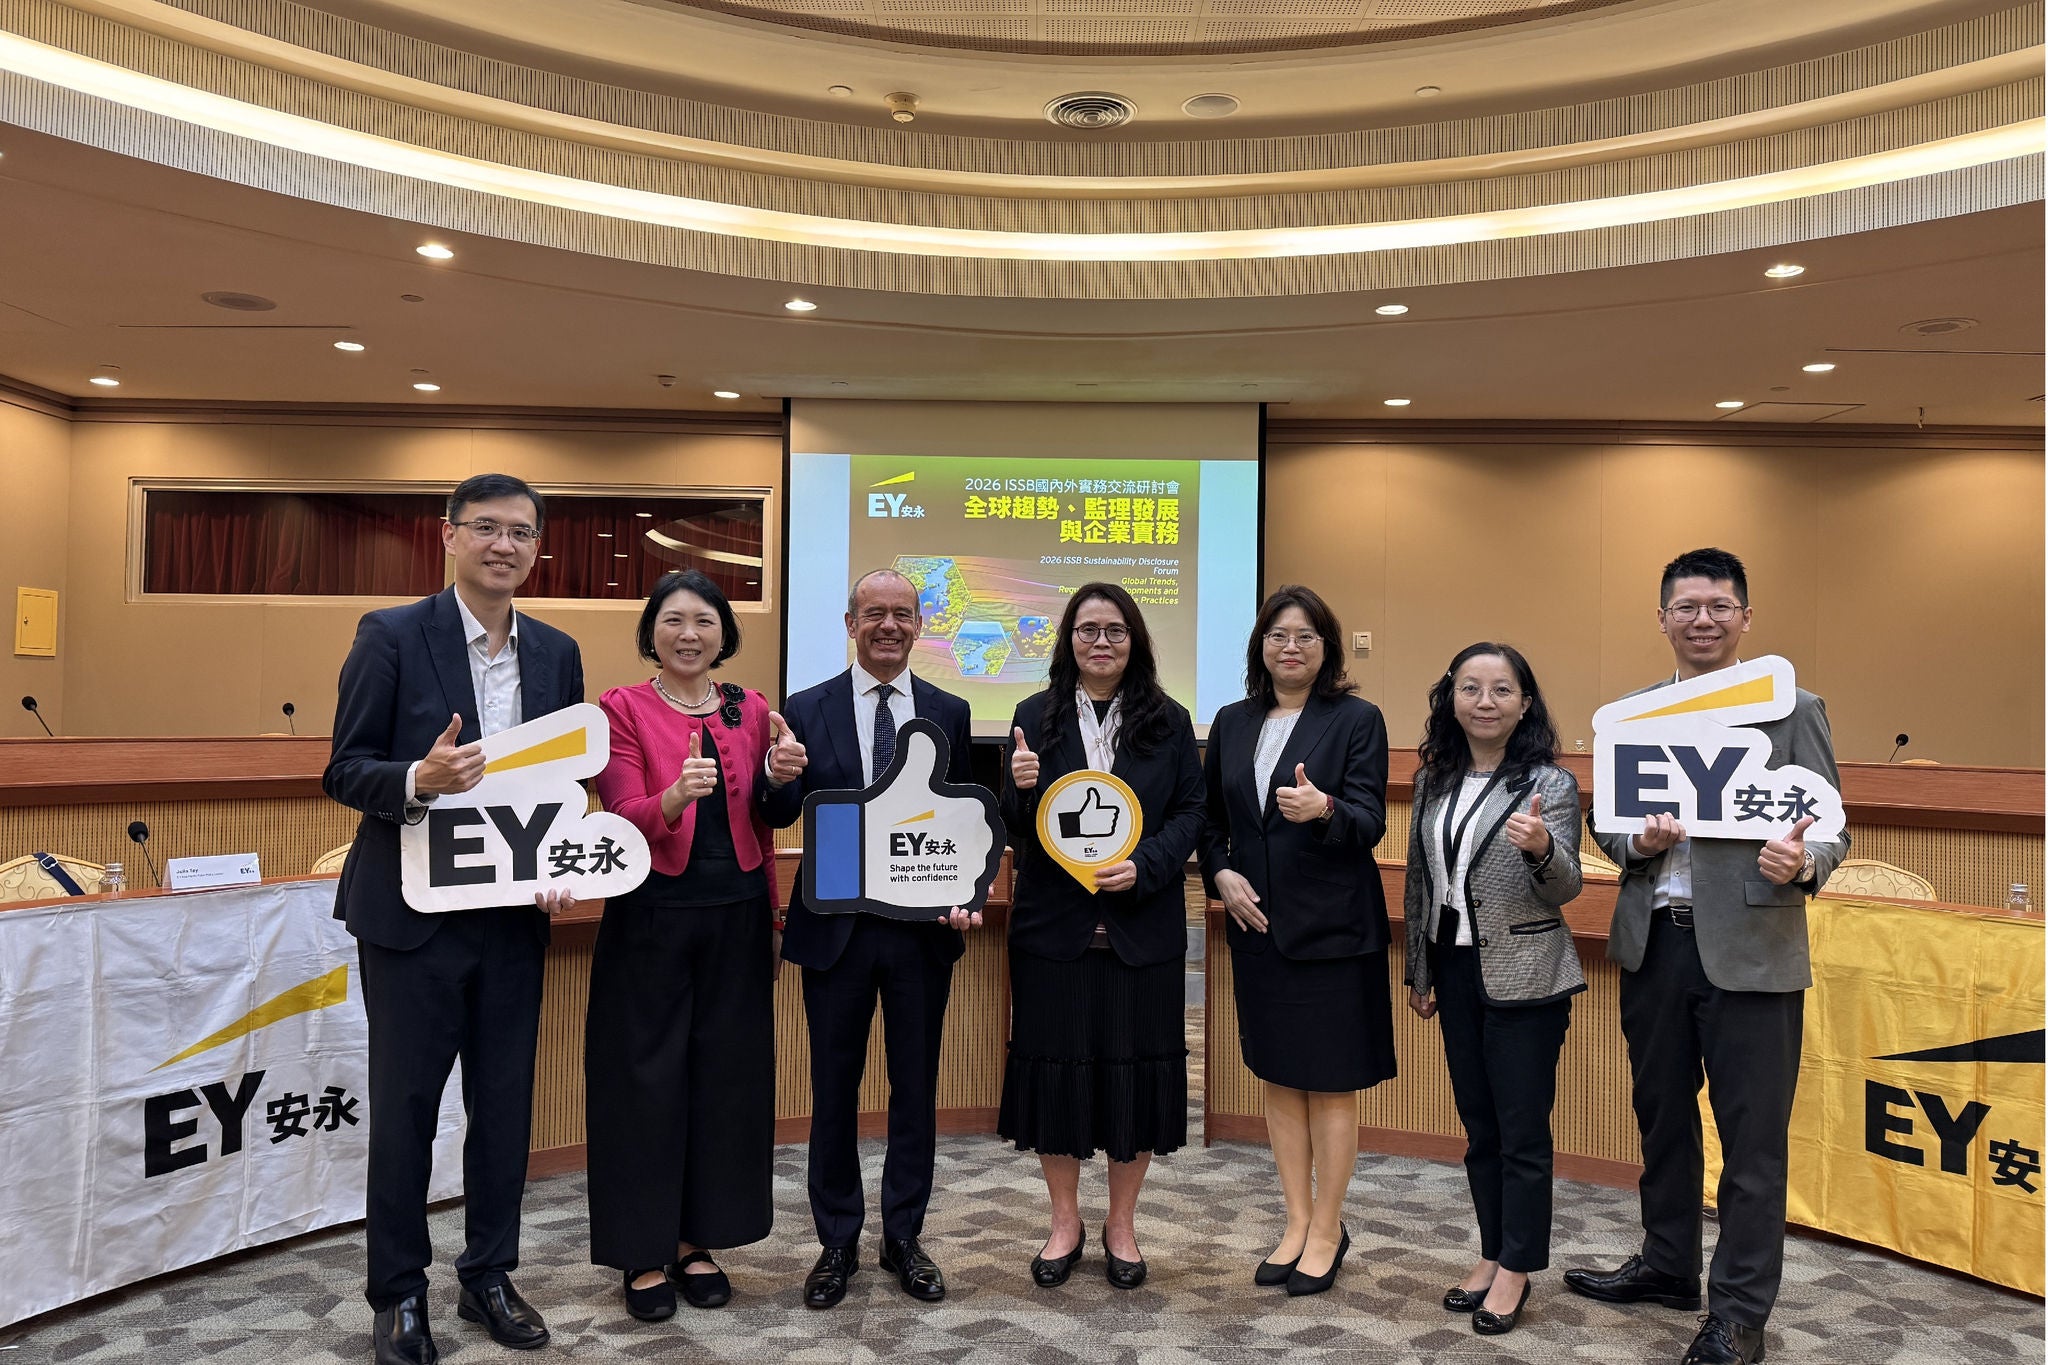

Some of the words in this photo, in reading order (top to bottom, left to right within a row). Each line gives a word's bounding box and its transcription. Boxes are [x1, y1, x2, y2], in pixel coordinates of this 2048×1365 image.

[965, 478, 1001, 491] 2026
[964, 495, 1180, 522] 全球趨勢、監理發展
[1059, 520, 1180, 545] 與企業實務
[1040, 556, 1061, 565] 2026
[1063, 556, 1082, 565] ISSB
[1084, 556, 1136, 566] Sustainability
[1139, 557, 1179, 566] Disclosure
[1153, 566, 1179, 575] Forum
[1121, 577, 1147, 585] Global
[1149, 577, 1178, 586] Trends,
[1124, 586, 1161, 596] lopments
[1163, 587, 1179, 595] and
[1140, 596, 1179, 605] Practices
[889, 864, 916, 873] Shape
[917, 863, 931, 872] the
[933, 863, 958, 871] future
[890, 874, 910, 883] with
[911, 873, 958, 882] confidence
